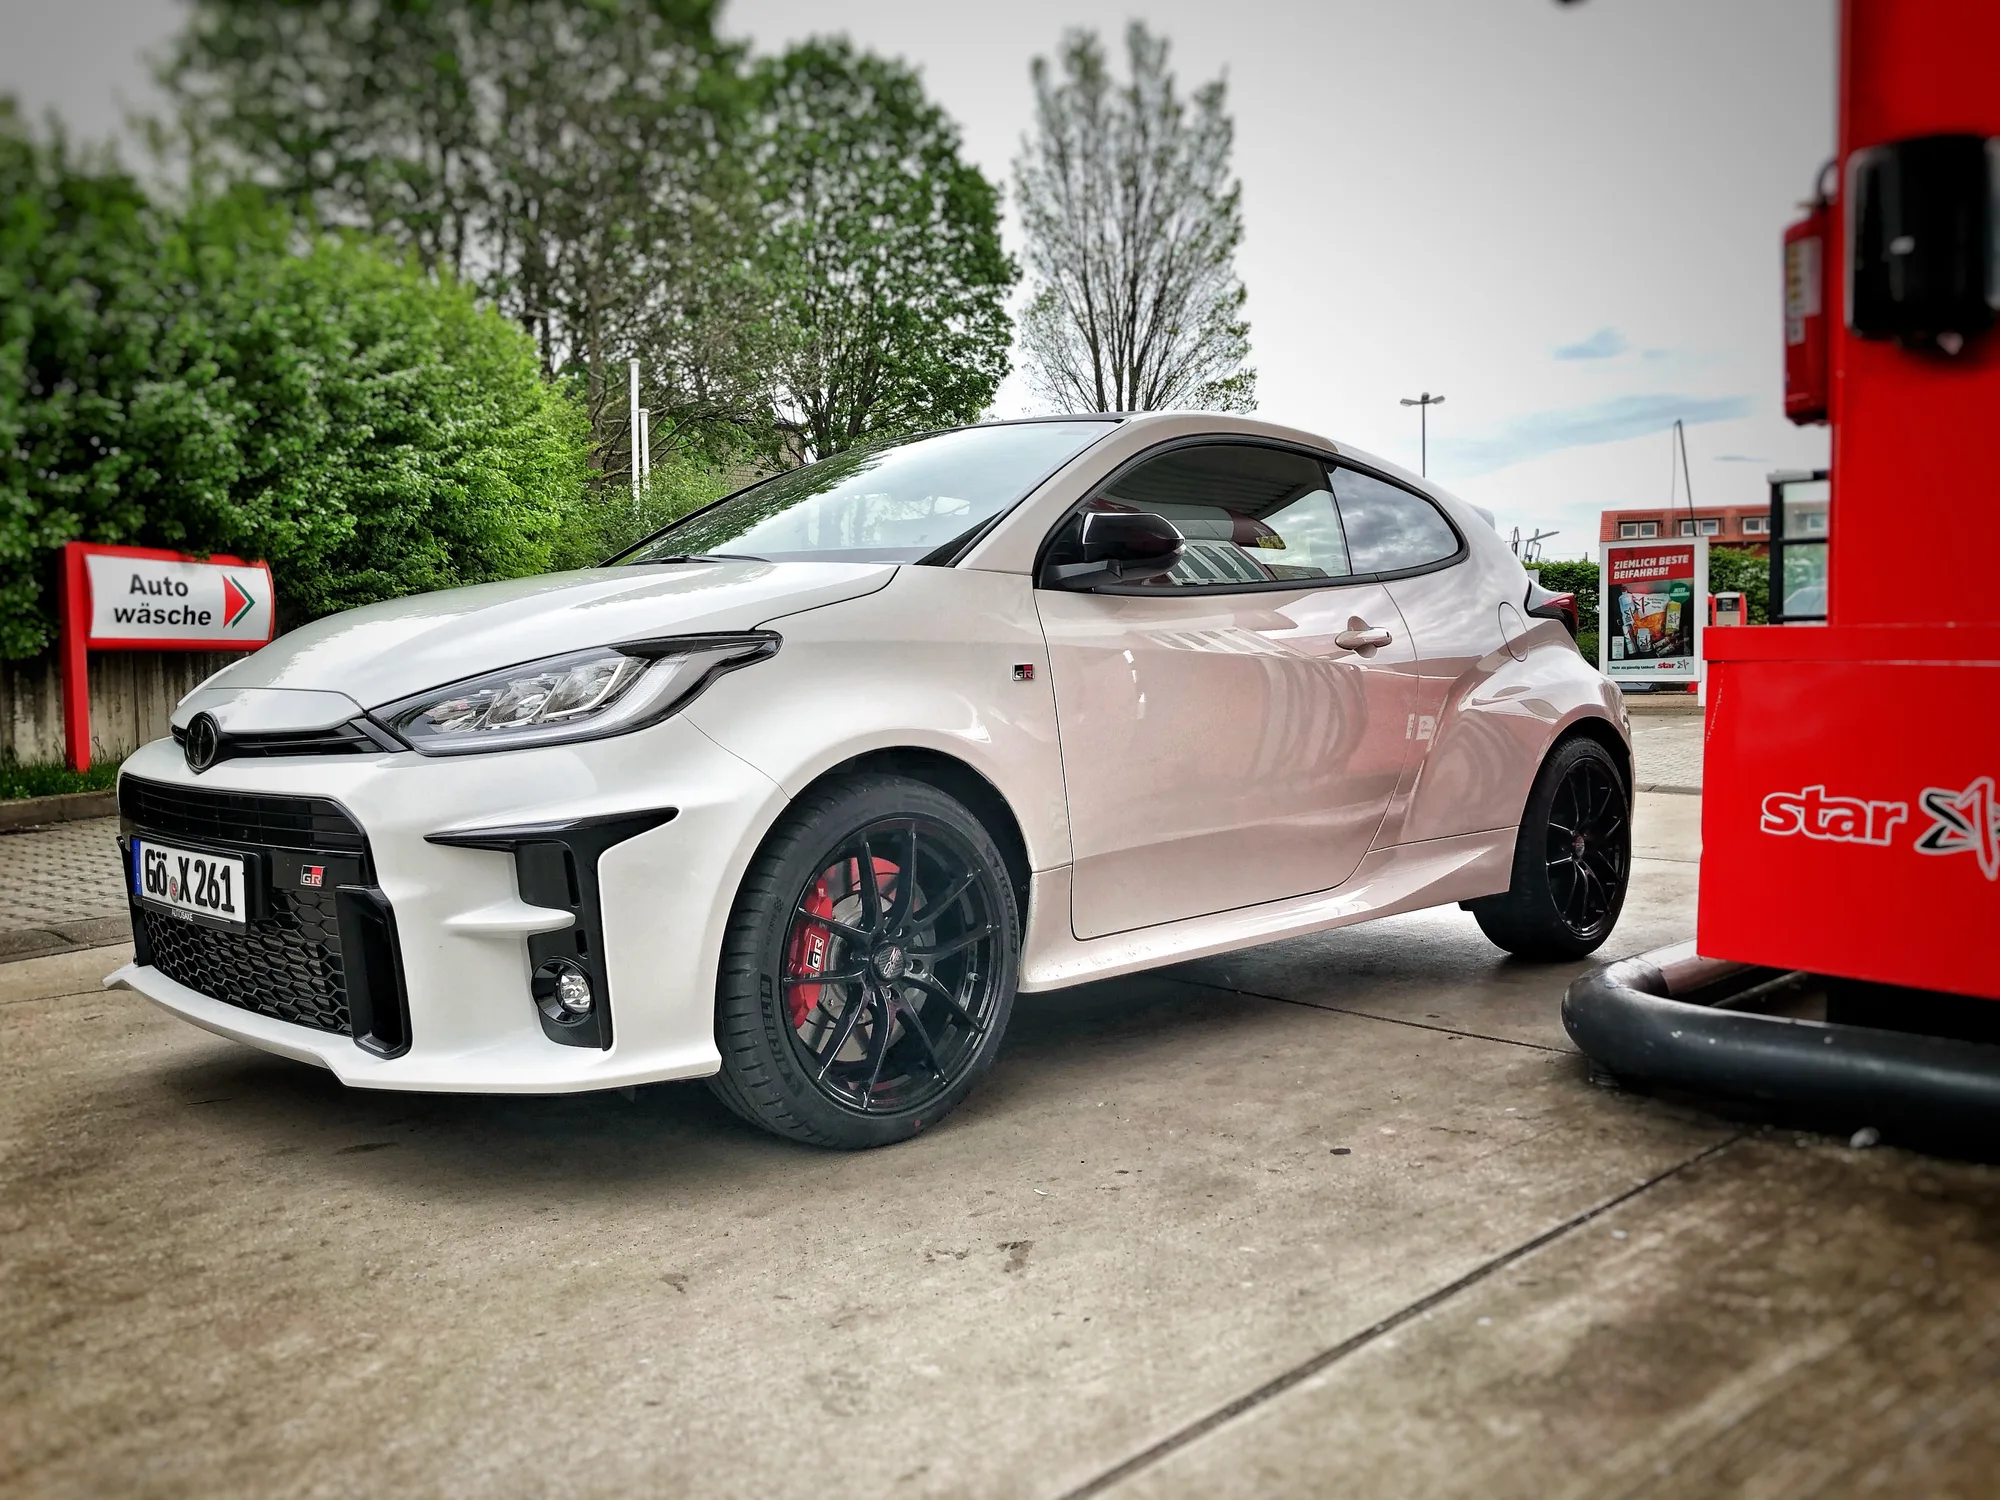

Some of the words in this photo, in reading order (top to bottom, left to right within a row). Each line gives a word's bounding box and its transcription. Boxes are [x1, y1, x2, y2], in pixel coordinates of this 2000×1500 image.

[1613, 566, 1669, 579] BEIFAHRER!
[1614, 557, 1657, 570] ZIEMLICH
[1658, 554, 1689, 566] BESTE
[129, 574, 189, 597] Auto
[113, 602, 212, 626] wäsche
[1657, 661, 1675, 669] star
[1760, 784, 1909, 847] star
[144, 848, 168, 897] GÖ
[177, 856, 192, 904] X
[194, 859, 235, 913] 261
[812, 938, 824, 969] GR
[760, 979, 791, 1075] MICHELIN
